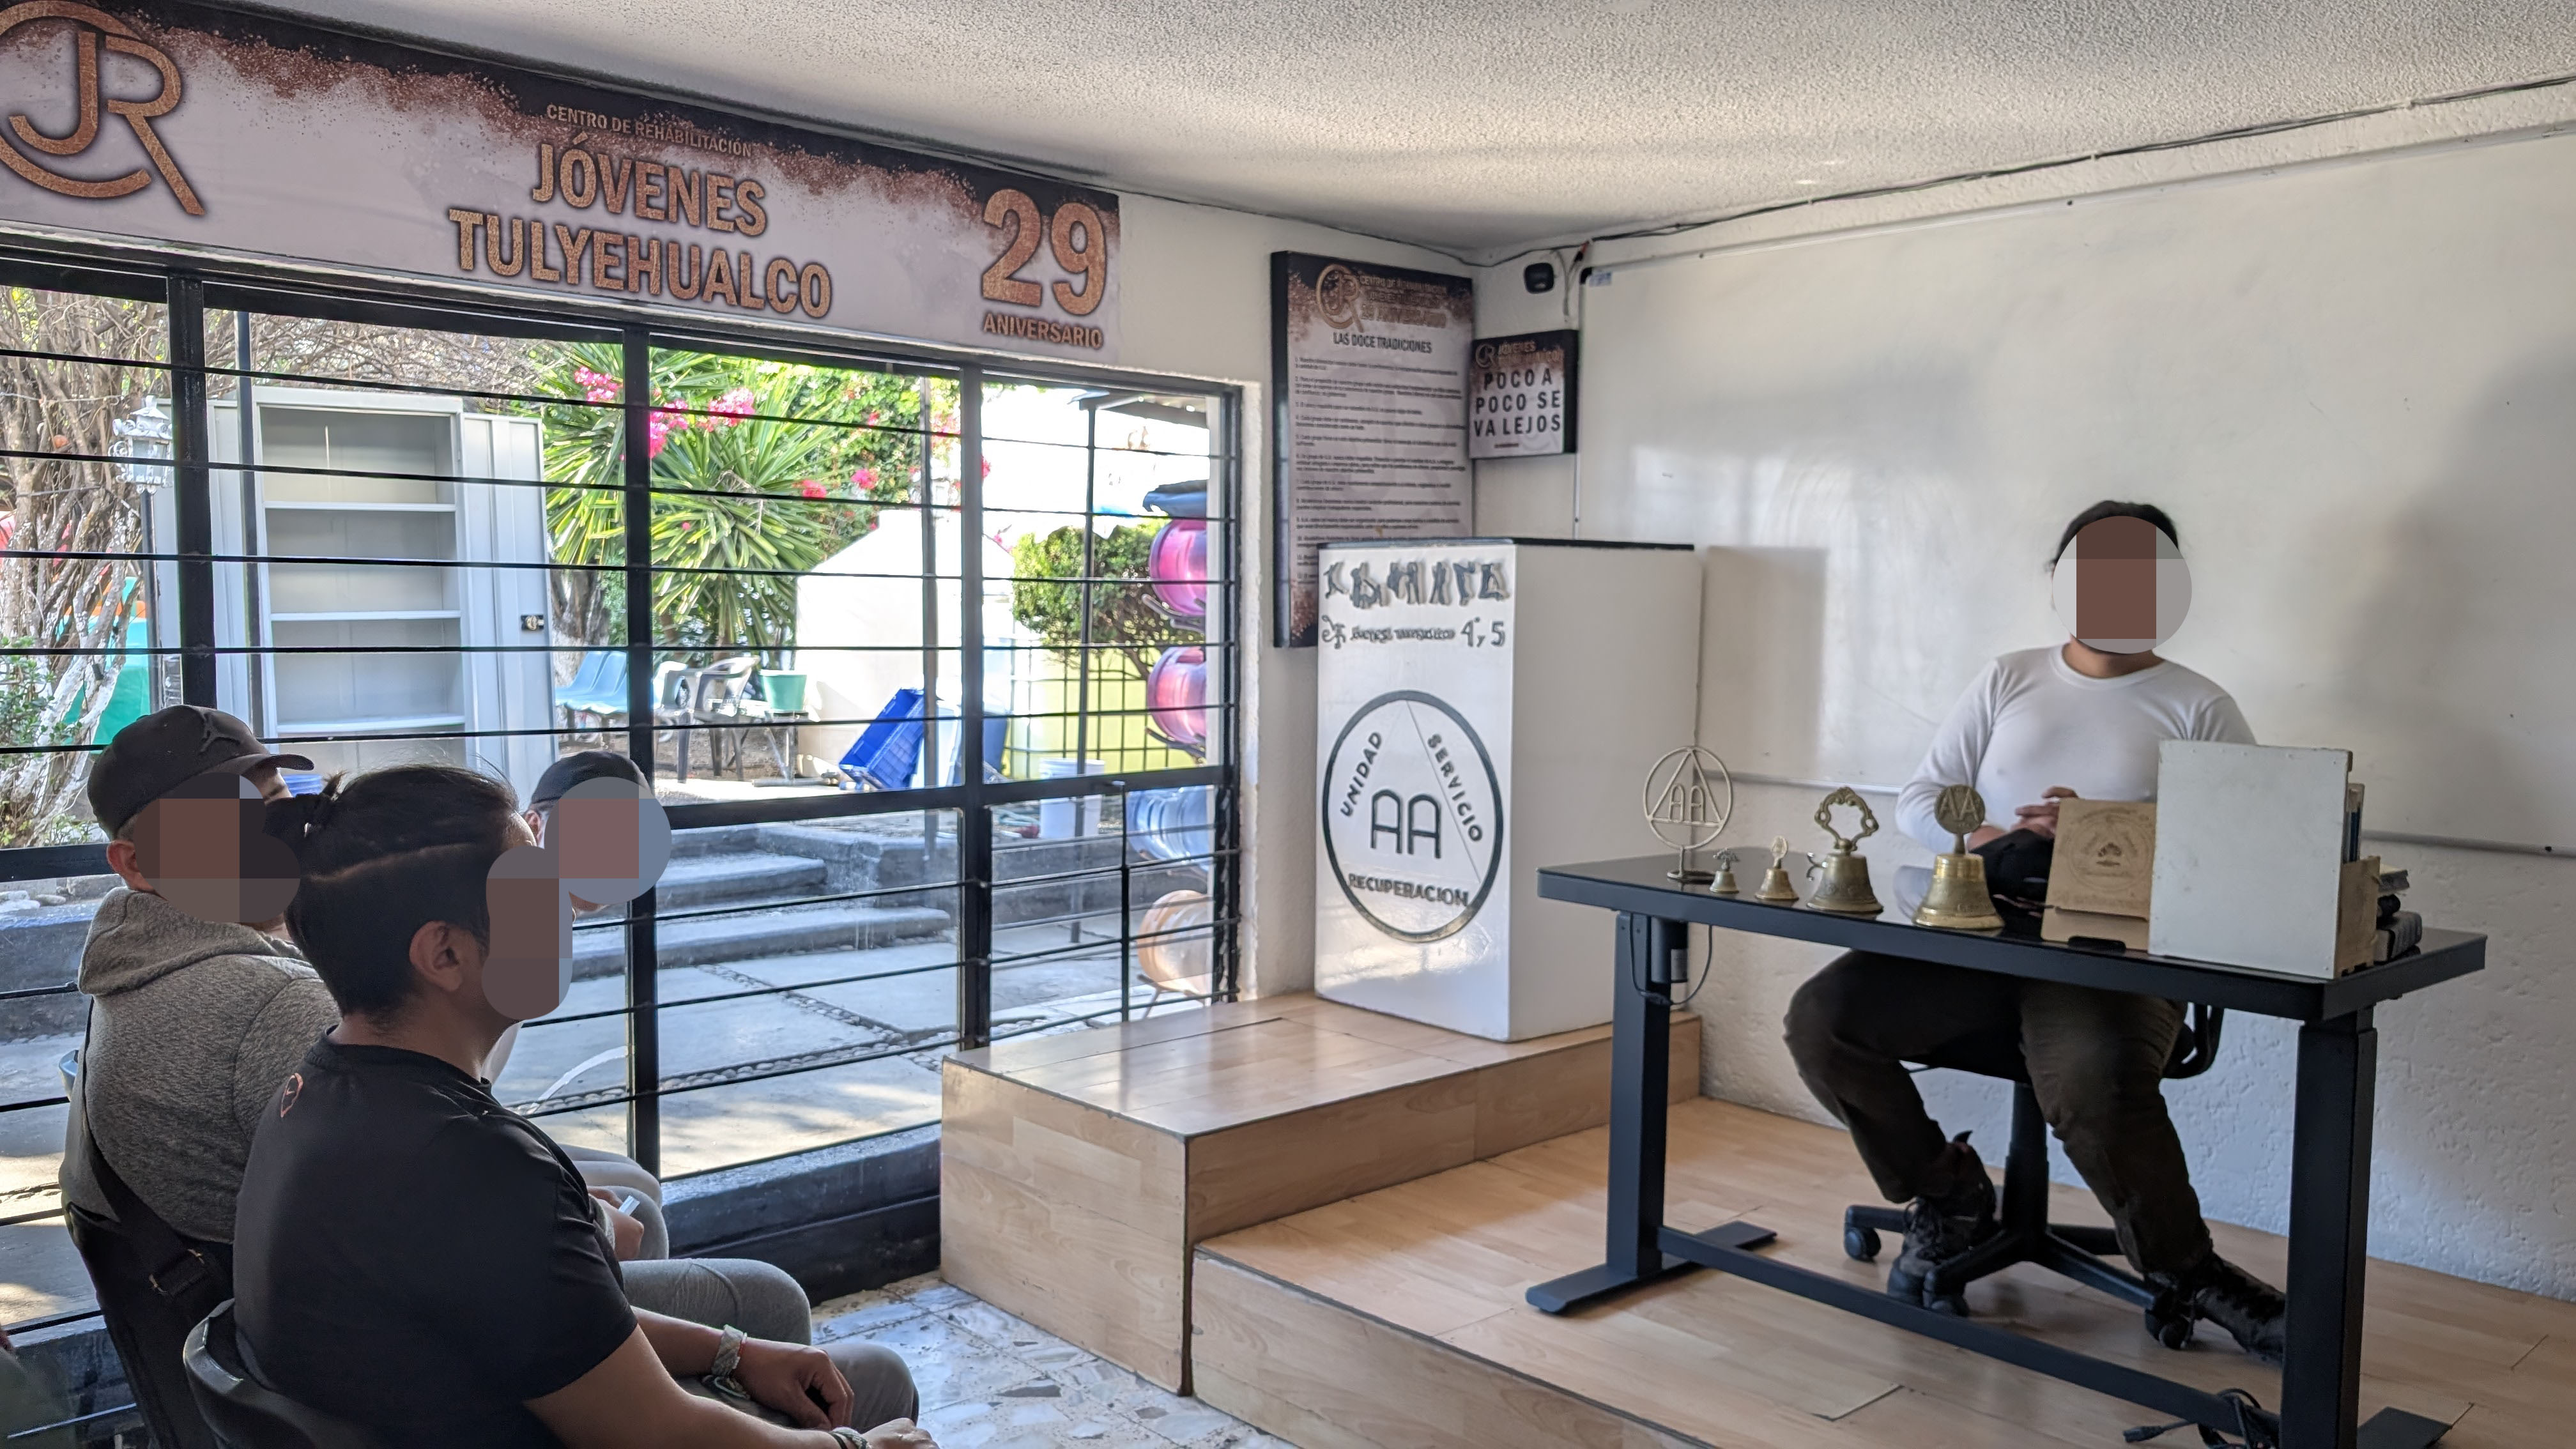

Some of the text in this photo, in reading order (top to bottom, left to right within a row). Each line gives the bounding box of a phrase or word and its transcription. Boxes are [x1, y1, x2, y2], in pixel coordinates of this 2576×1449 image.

[546, 103, 753, 157] CENTRO DE REHABILITACIÓN
[532, 131, 767, 237] JÓVENES
[449, 208, 831, 318] TULYEHUALCO
[982, 188, 1107, 316] 29
[983, 313, 1103, 349] ANIVERSARIO
[1333, 332, 1432, 353] LAS DOCE TRADICIONES
[1483, 368, 1535, 391] POCO
[1542, 367, 1552, 386] A
[1476, 390, 1561, 415] POCO SE
[1474, 418, 1496, 438] VA
[1503, 414, 1561, 436] LEJOS
[1340, 731, 1383, 817] UNIDAD
[1427, 733, 1483, 843] SERVICIO
[1369, 788, 1442, 859] AA
[1940, 788, 1980, 822] AA
[1347, 872, 1469, 907] RECUPERACION
